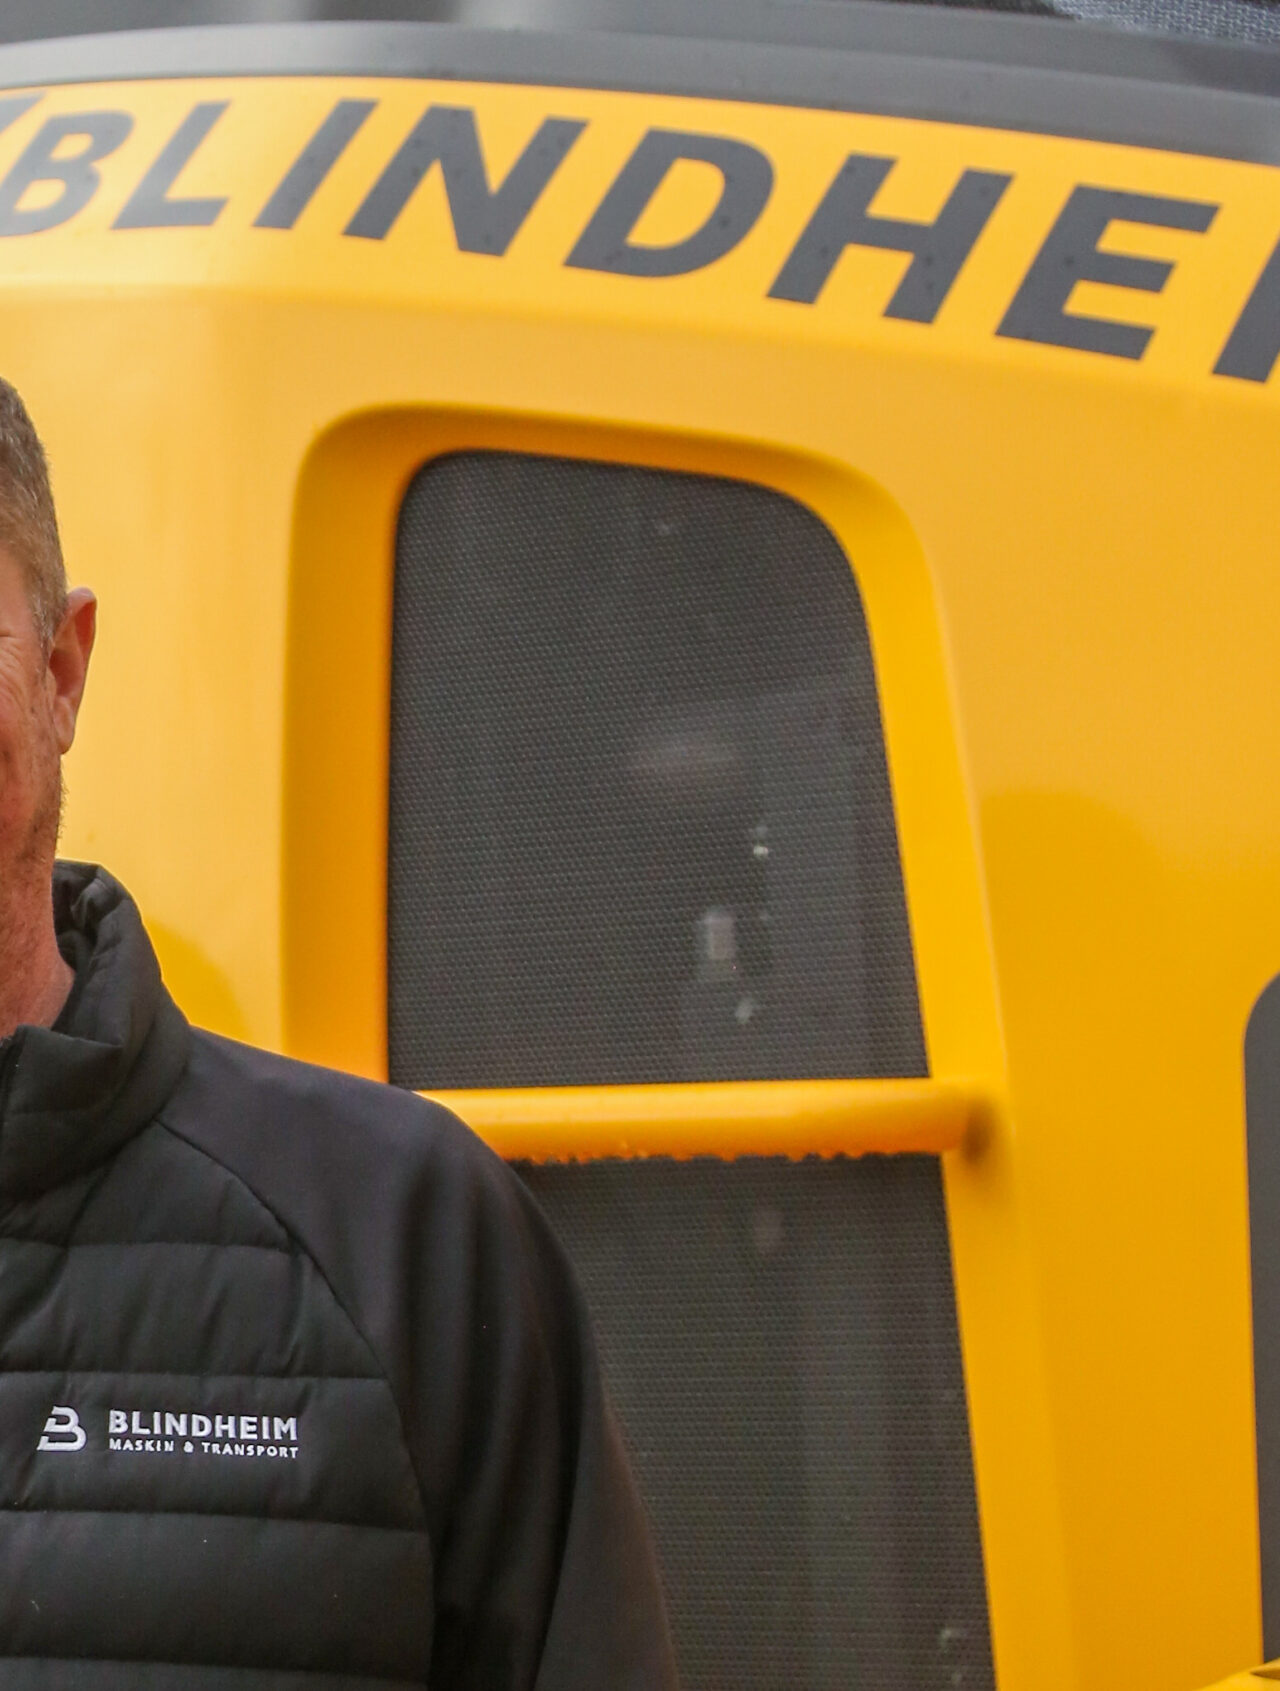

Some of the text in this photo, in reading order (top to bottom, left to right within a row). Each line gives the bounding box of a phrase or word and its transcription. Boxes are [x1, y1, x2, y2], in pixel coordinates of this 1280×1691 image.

[108, 1408, 299, 1441] BLINDHEIM
[108, 1438, 298, 1458] MASKIN & TRANSPORT
